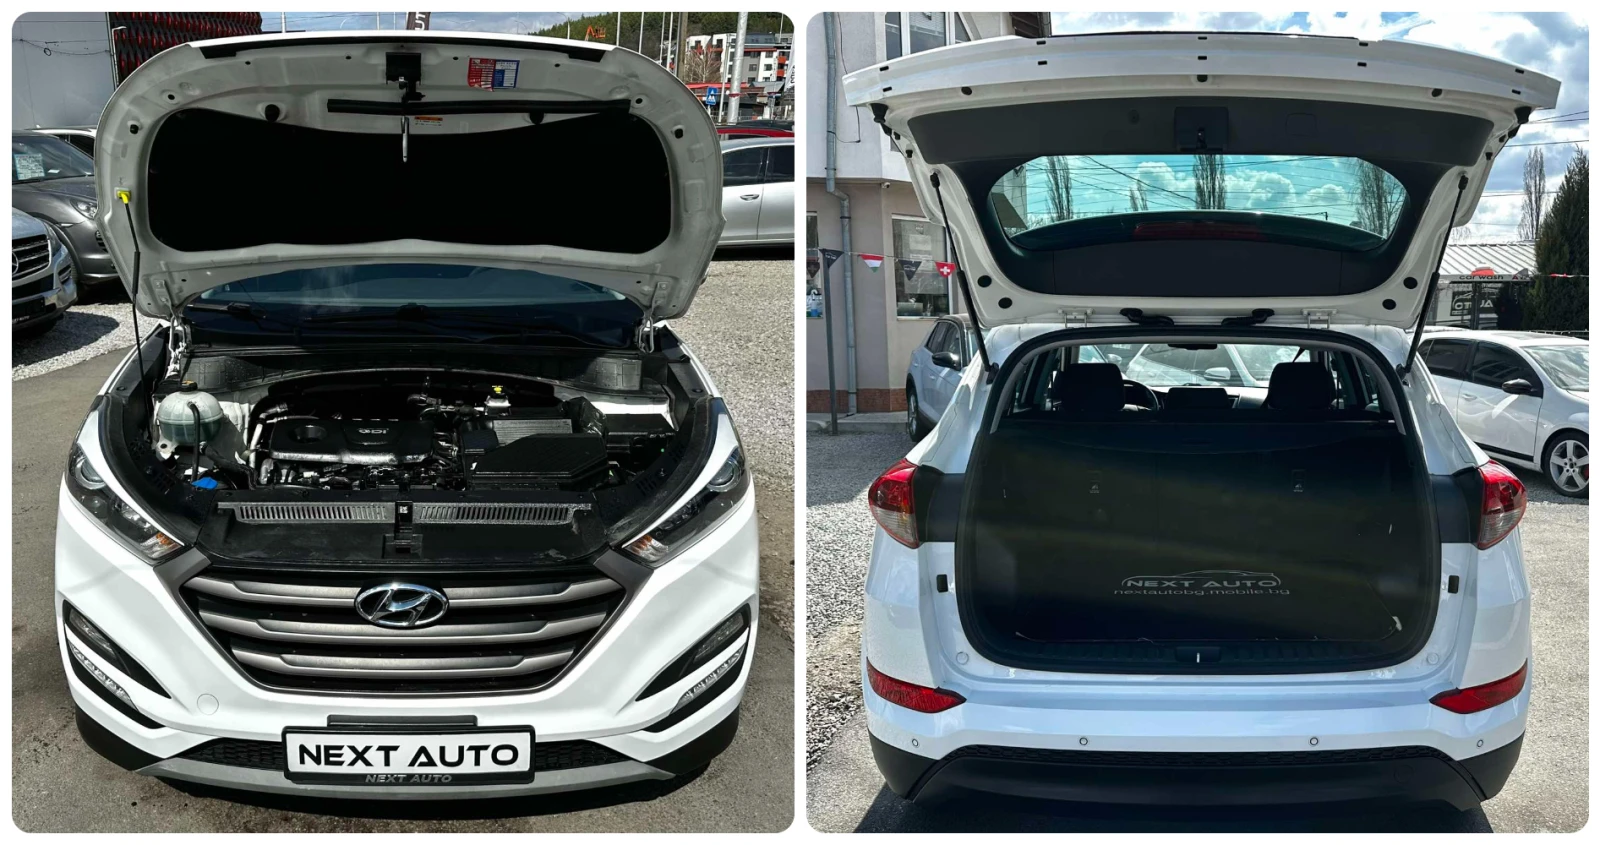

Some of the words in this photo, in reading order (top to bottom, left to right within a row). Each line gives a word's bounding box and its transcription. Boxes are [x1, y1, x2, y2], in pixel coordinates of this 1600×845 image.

[299, 744, 400, 767] NEXT
[408, 744, 519, 768] AUTO
[365, 774, 405, 783] NEXT
[410, 774, 452, 783] AUTO
